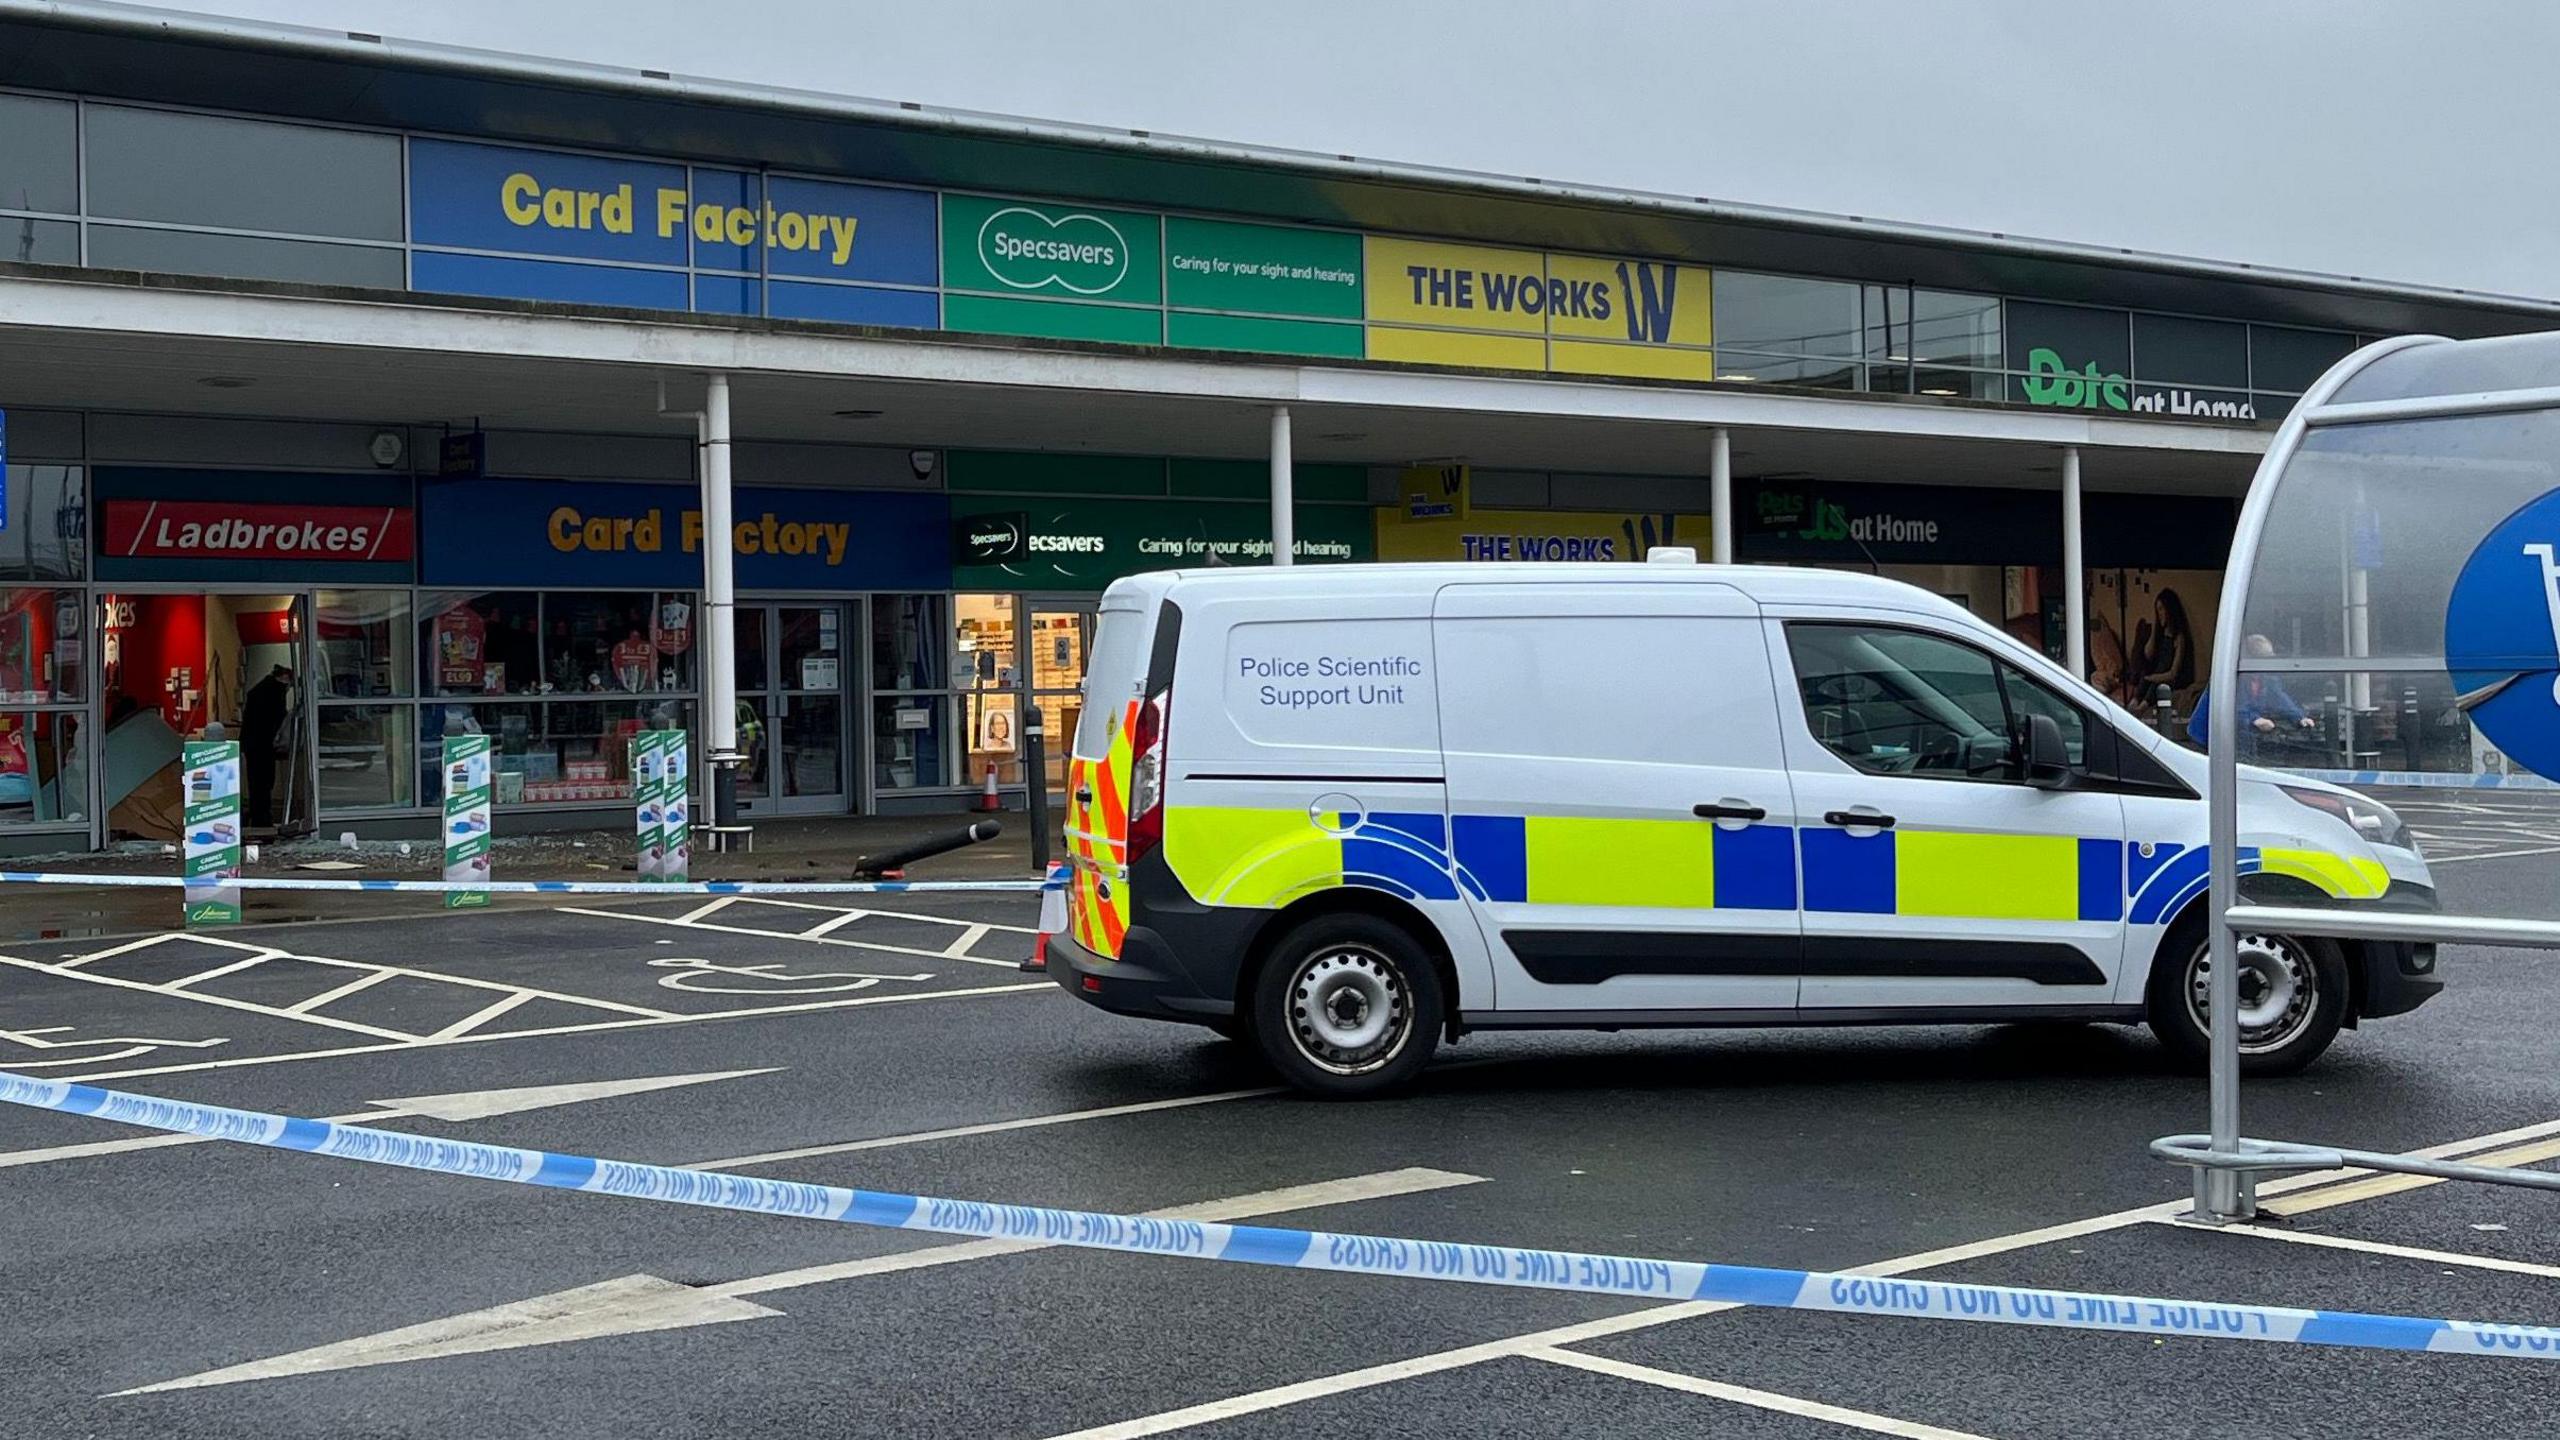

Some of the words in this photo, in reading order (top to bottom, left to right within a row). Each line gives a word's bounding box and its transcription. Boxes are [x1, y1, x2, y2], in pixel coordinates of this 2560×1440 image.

[501, 173, 632, 234] Card
[657, 188, 857, 265] Factory
[994, 231, 1114, 266] Specsavers
[1172, 255, 1210, 274] Caring
[1212, 257, 1231, 272] for
[1233, 261, 1259, 276] your
[1261, 261, 1288, 280] sight
[1291, 265, 1311, 279] and
[1313, 265, 1355, 286] hearing
[1407, 265, 1473, 309] THE
[1481, 272, 1611, 320] WORKS
[1616, 261, 1677, 343] W
[1410, 504, 1453, 516] WORKS
[156, 518, 369, 551] Ladbrokes
[548, 507, 661, 552] Card
[681, 510, 849, 565] Fctory
[970, 532, 1012, 546] Specsavers
[1850, 516, 1873, 540] at
[1876, 514, 1938, 542] Home
[1028, 534, 1105, 552] ecsavers
[1138, 537, 1183, 558] Caring
[1186, 538, 1204, 553] for
[1208, 541, 1240, 555] your
[1243, 539, 1273, 558] sight
[1303, 540, 1352, 559] hearing
[1461, 535, 1511, 562] THE
[1517, 536, 1615, 562] WORKS
[1240, 656, 1310, 678] Police
[1318, 656, 1421, 677] Scientific
[1260, 685, 1350, 710] Support
[1358, 684, 1404, 704] Unit
